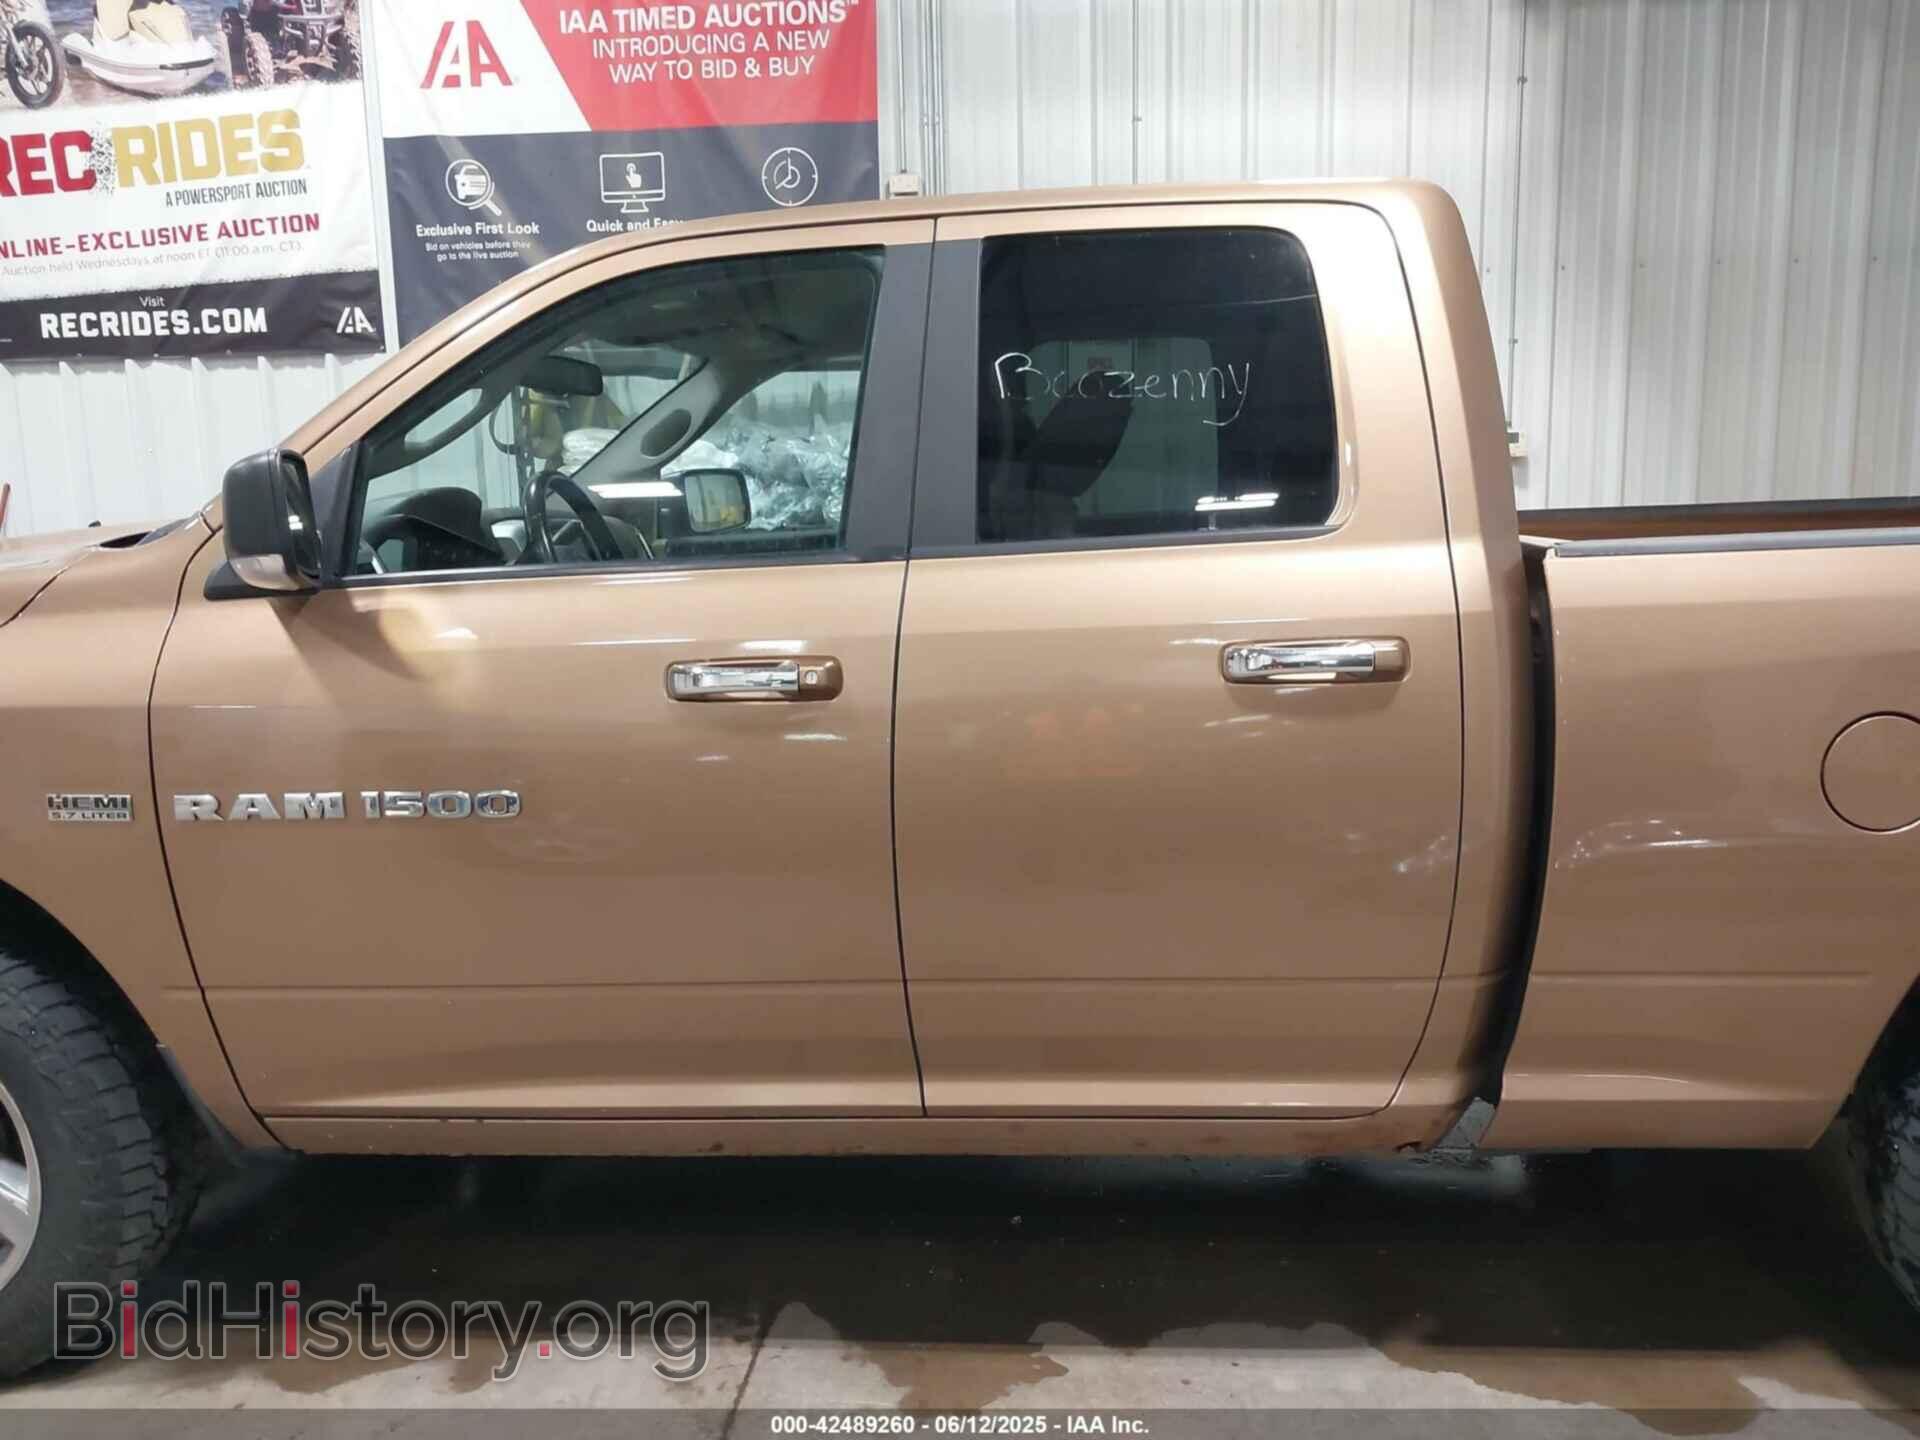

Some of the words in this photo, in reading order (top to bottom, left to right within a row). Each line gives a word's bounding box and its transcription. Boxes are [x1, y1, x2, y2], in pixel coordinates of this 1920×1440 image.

[559, 10, 608, 34] IAA
[612, 9, 696, 33] TIMED
[592, 34, 745, 58] INTRODUCING
[753, 32, 769, 51] A
[776, 29, 830, 51] NEW
[608, 62, 658, 84] WAY
[663, 60, 693, 80] TO
[701, 58, 737, 78] BID
[744, 57, 761, 77] &
[768, 55, 815, 76] BUY
[112, 108, 305, 188] RIDES
[165, 192, 174, 207] A
[175, 183, 252, 206] POWERSPORT
[255, 178, 307, 199] AUCTION
[0, 223, 208, 259] NLINE-EXCLUSIVE
[217, 213, 320, 240] AUCTION
[416, 223, 472, 237] Exclusive
[475, 222, 504, 235] First
[507, 222, 540, 234] Look
[586, 218, 623, 232] Quick
[626, 219, 651, 232] and
[451, 240, 483, 250] vehicles
[485, 239, 511, 249] before
[458, 251, 471, 259] the
[140, 296, 164, 308] Visit
[40, 307, 268, 339] RECRIDES.COM
[47, 796, 128, 809] HEMI
[81, 811, 128, 819] LITER
[173, 792, 345, 822] RAM
[361, 790, 522, 820] 1500
